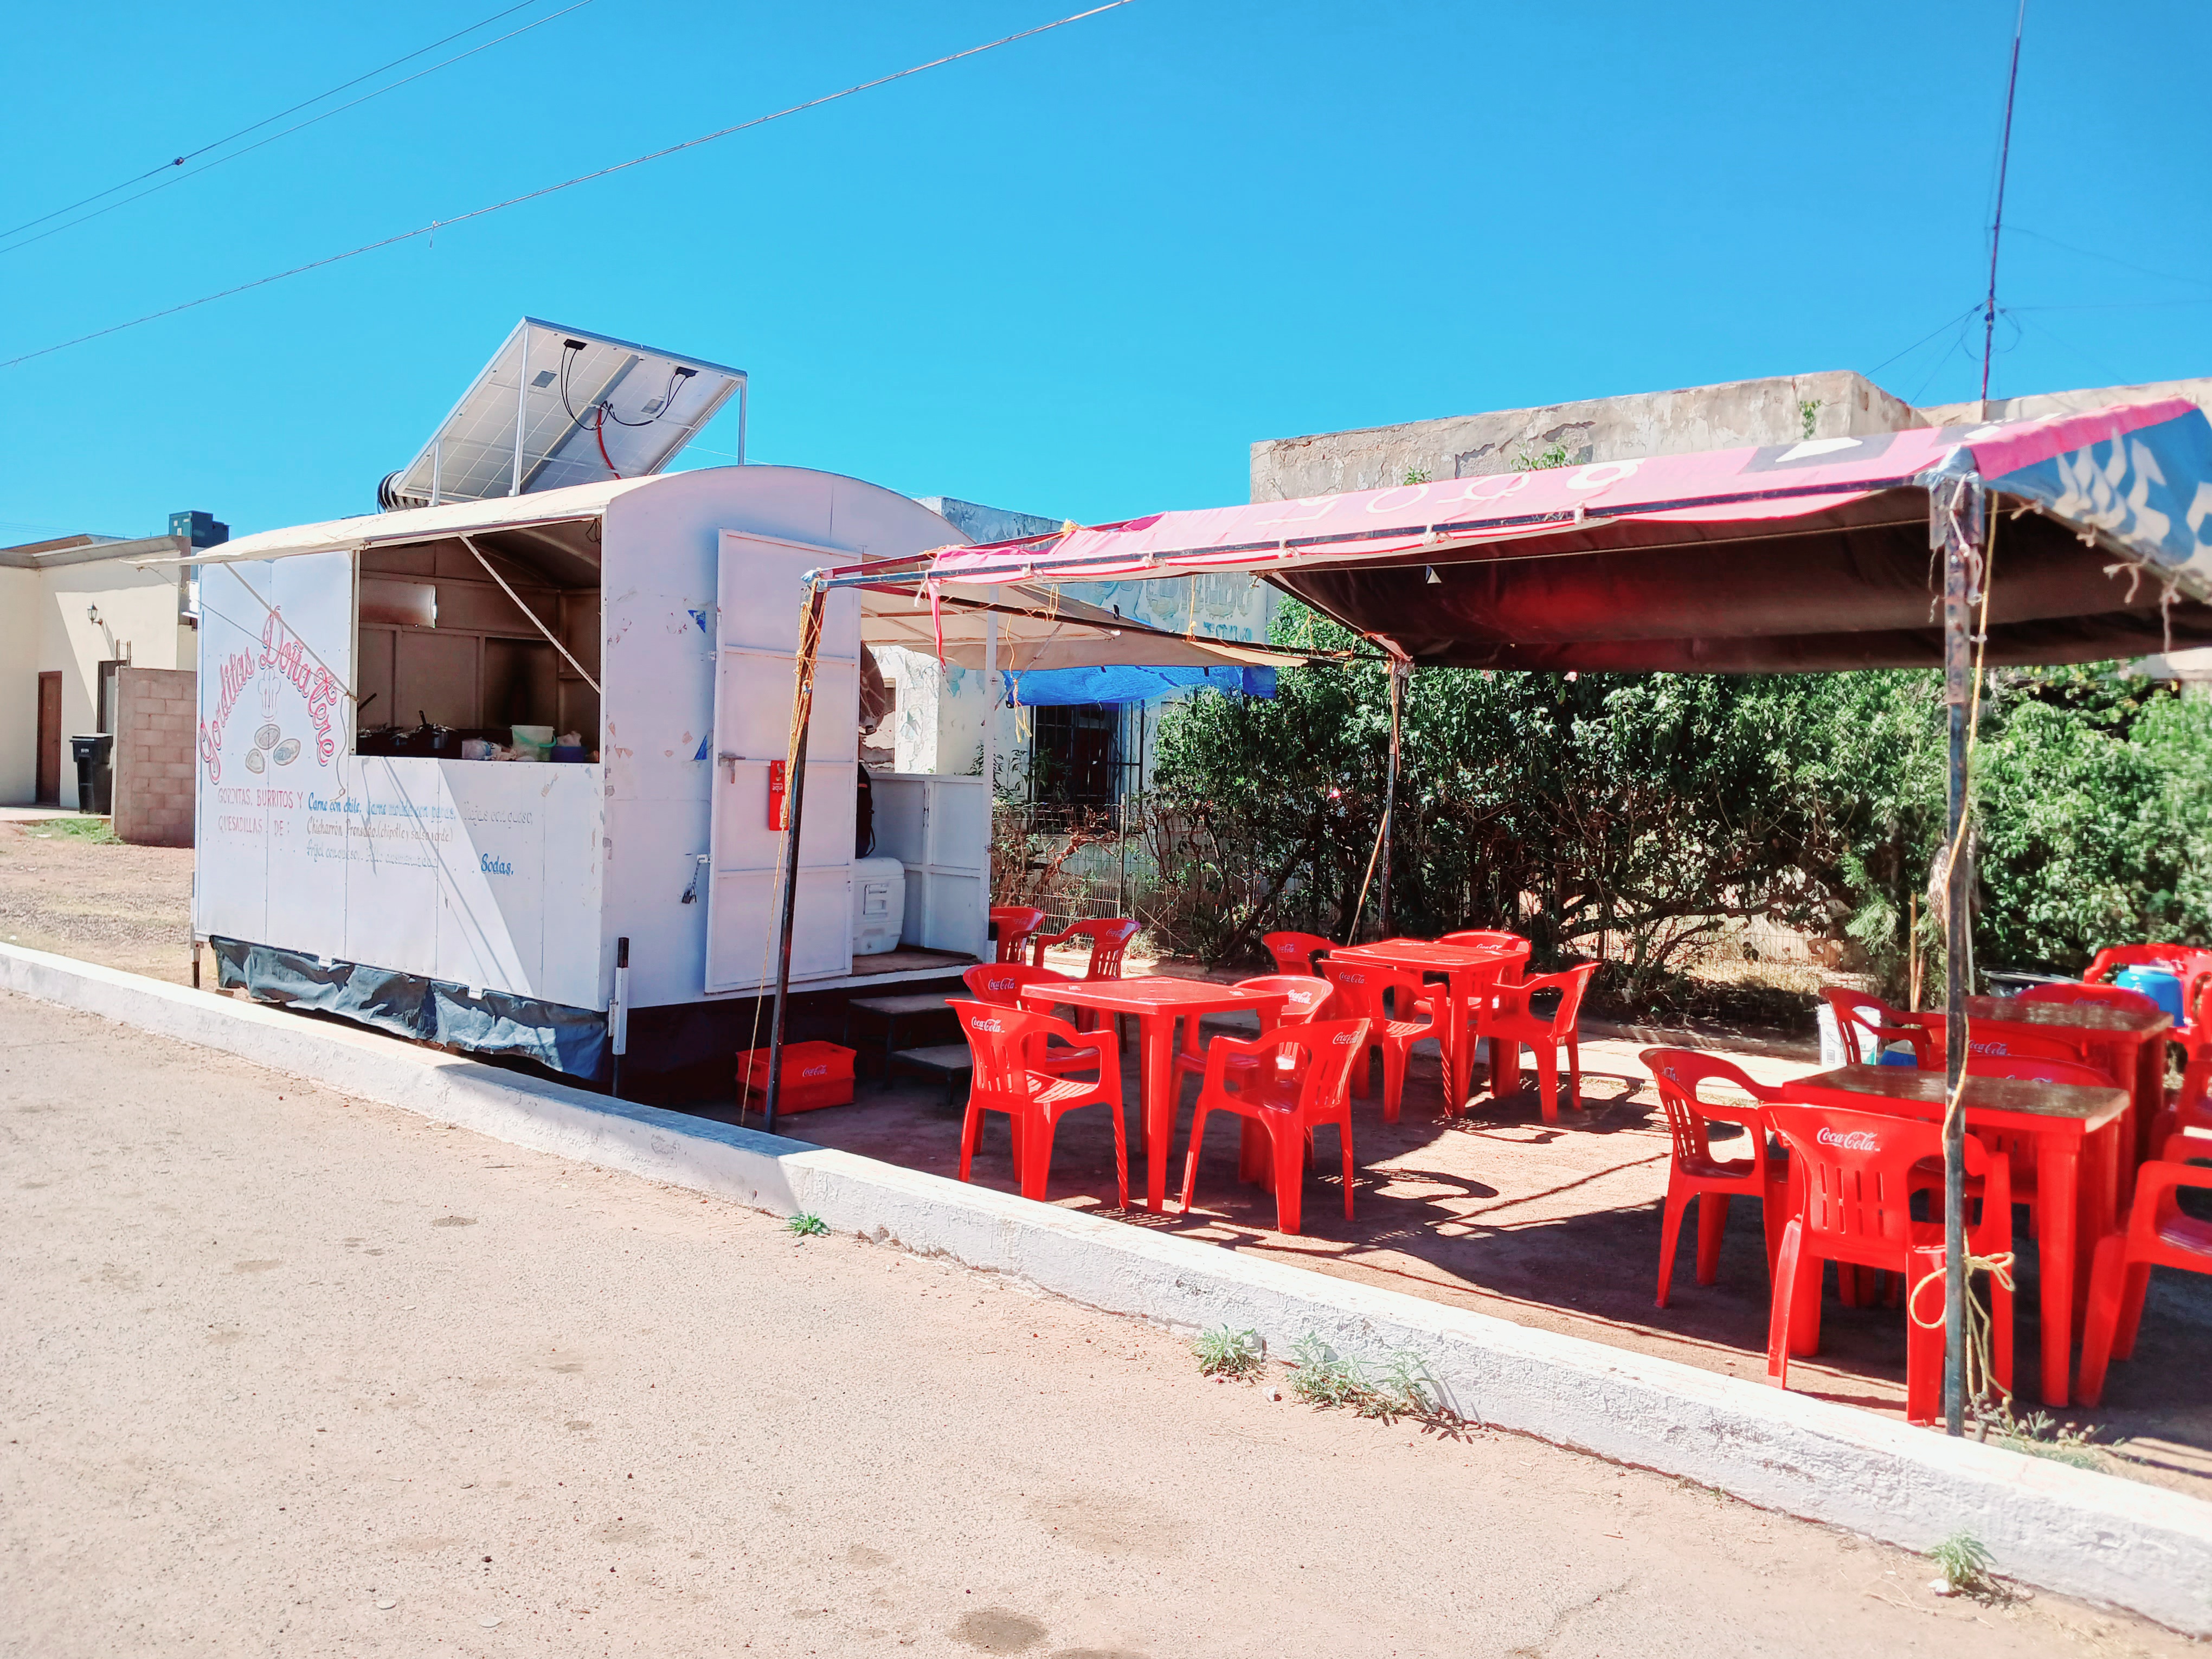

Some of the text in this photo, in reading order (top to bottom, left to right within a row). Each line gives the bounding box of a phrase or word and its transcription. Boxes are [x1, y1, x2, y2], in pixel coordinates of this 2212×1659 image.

[259, 605, 311, 698] Doña
[256, 789, 293, 808] BURRITOS
[297, 792, 303, 809] Y
[308, 792, 327, 811] Carne
[330, 801, 341, 812] con
[218, 815, 262, 834] QUESADILLAS
[307, 815, 343, 836] Chicharrón
[481, 853, 513, 876] Sodas.
[988, 978, 1015, 992] Coca-Cola
[971, 1016, 1002, 1033] Coca-Cola
[1817, 1127, 1877, 1152] Coca-Cola
